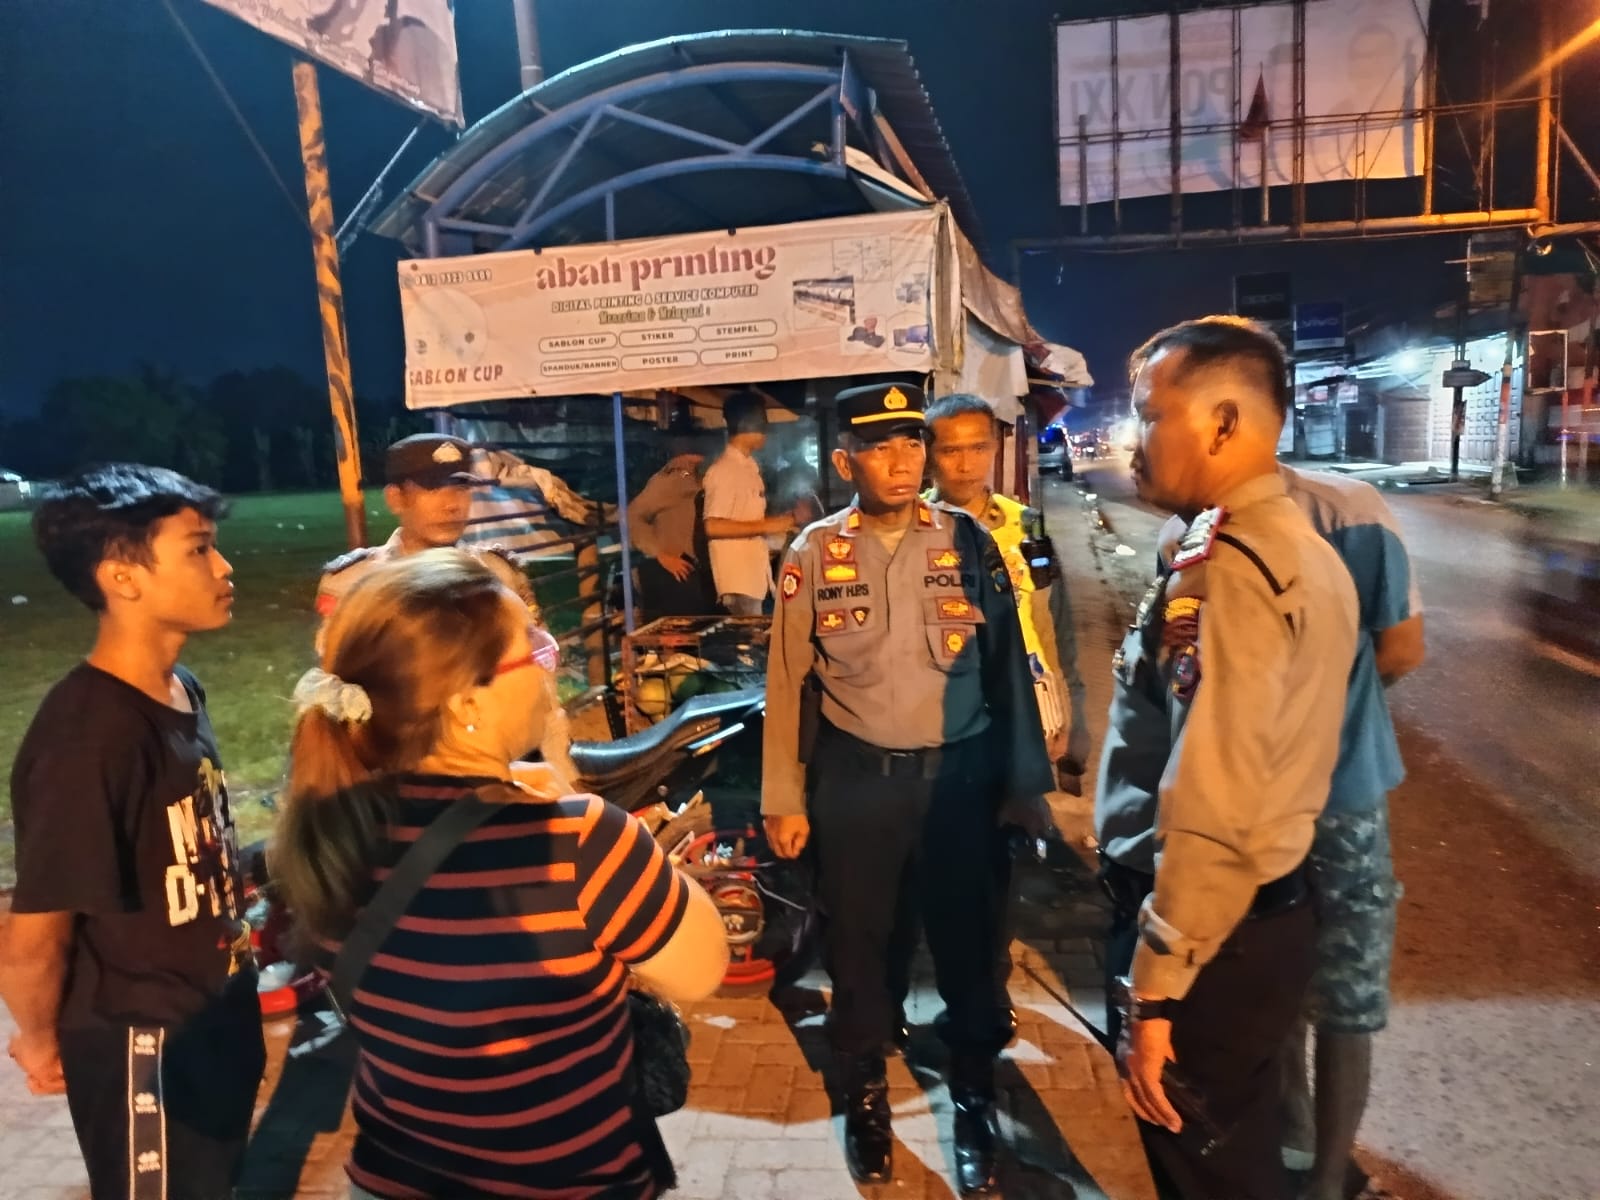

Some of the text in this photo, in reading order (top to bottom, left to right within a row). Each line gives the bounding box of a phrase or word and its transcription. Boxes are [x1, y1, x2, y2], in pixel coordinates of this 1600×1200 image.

[630, 245, 776, 291] printing
[551, 299, 592, 313] DIGITAL
[593, 293, 643, 309] PRINTING
[654, 289, 699, 304] SERVICE
[700, 284, 759, 300] KOMPUTER
[641, 331, 675, 341] STIKER
[716, 324, 760, 336] STEMPEL
[548, 337, 607, 348] SABLON CUP
[642, 355, 679, 366] POSTER
[725, 350, 754, 360] PRINT
[473, 364, 503, 382] CUP
[817, 586, 843, 602] RONY
